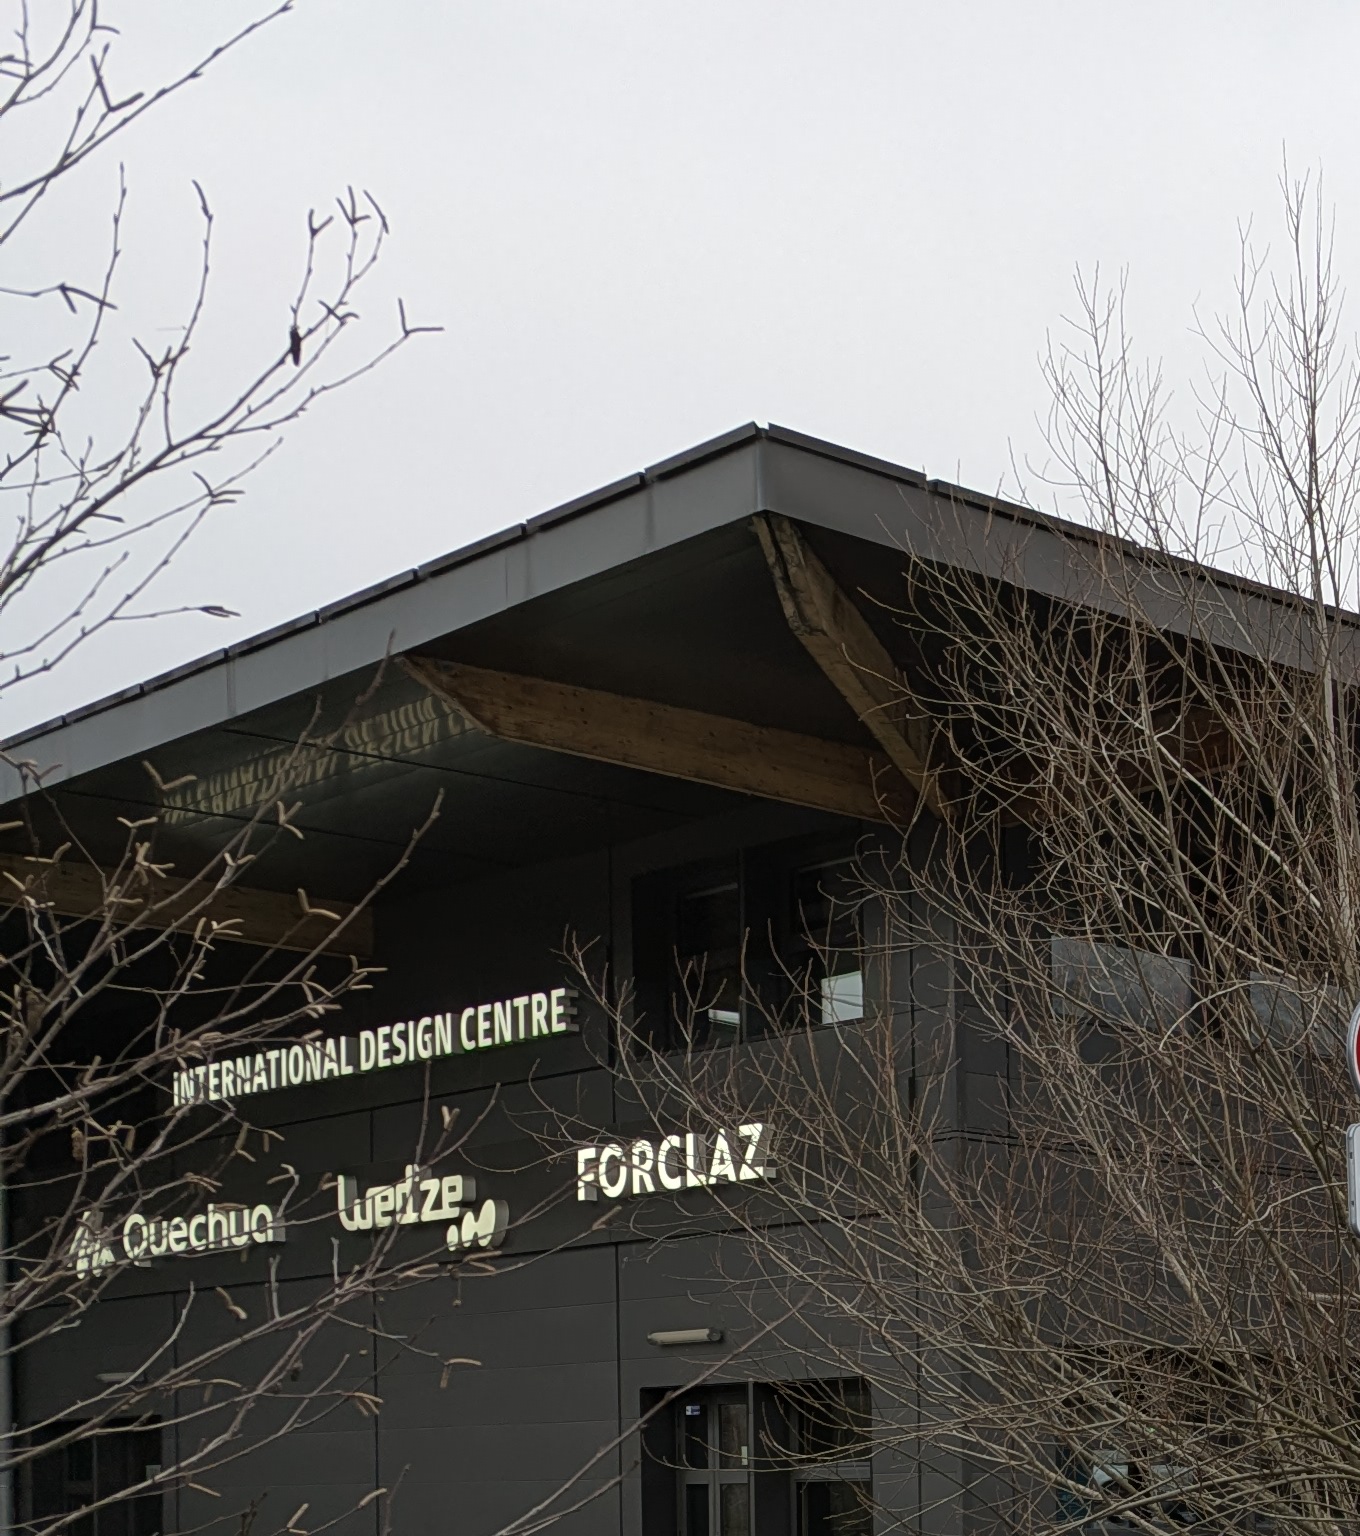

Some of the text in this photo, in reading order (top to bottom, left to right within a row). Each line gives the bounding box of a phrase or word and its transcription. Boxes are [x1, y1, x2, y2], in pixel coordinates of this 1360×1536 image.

[173, 988, 567, 1106] INTERNATIONAL DESIGN CENTRE
[577, 1122, 764, 1201] FORCLAZ
[123, 1203, 273, 1266] Quechua
